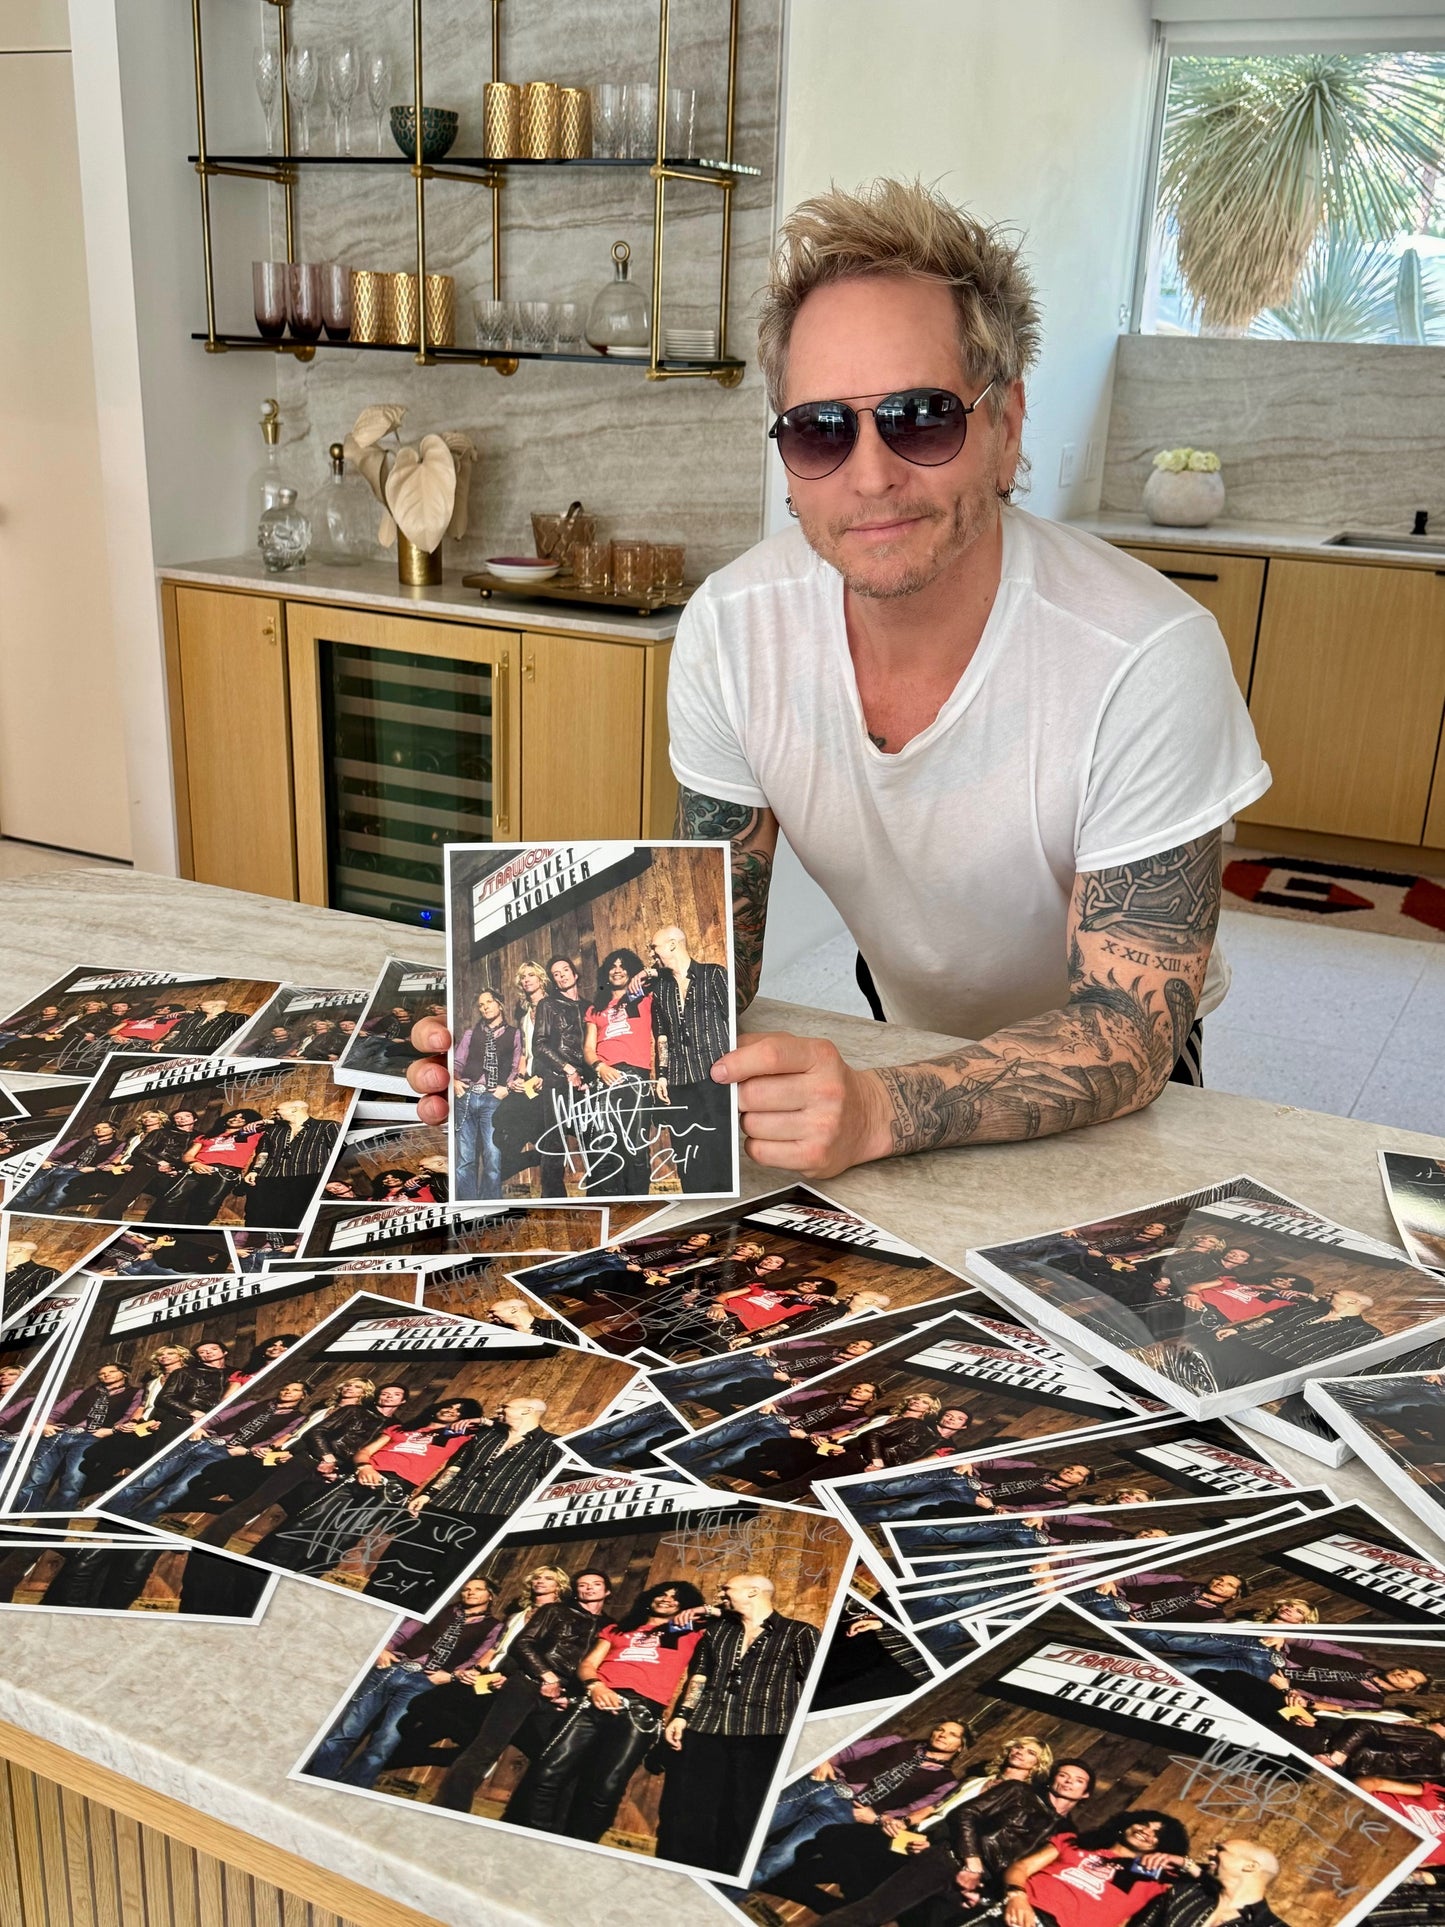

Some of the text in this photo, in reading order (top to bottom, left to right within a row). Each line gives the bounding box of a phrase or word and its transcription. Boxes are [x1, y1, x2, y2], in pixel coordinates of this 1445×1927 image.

[512, 848, 574, 898] VELVET
[504, 861, 590, 923] REVOLVER
[144, 1066, 236, 1091] REVOLVER
[158, 1059, 225, 1080] VELVET
[366, 1213, 462, 1244] REVOLVER
[379, 1206, 447, 1230] VELVET
[803, 1217, 879, 1236] VELVET
[1232, 1214, 1345, 1245] REVOLVER
[1258, 1211, 1342, 1235] VELVET
[777, 1219, 879, 1247] REVOLVER
[152, 1284, 262, 1323] REVOLVER
[167, 1277, 246, 1307] VELVET
[368, 1337, 489, 1351] REVOLVER
[394, 1325, 483, 1339] VELVET
[945, 1362, 1067, 1394] REVOLVER
[973, 1357, 1064, 1381] VELVET
[566, 1485, 662, 1511] VELVET
[543, 1498, 675, 1529] REVOLVER
[1089, 1672, 1209, 1711] VELVET
[1055, 1681, 1215, 1734] REVOLVER
